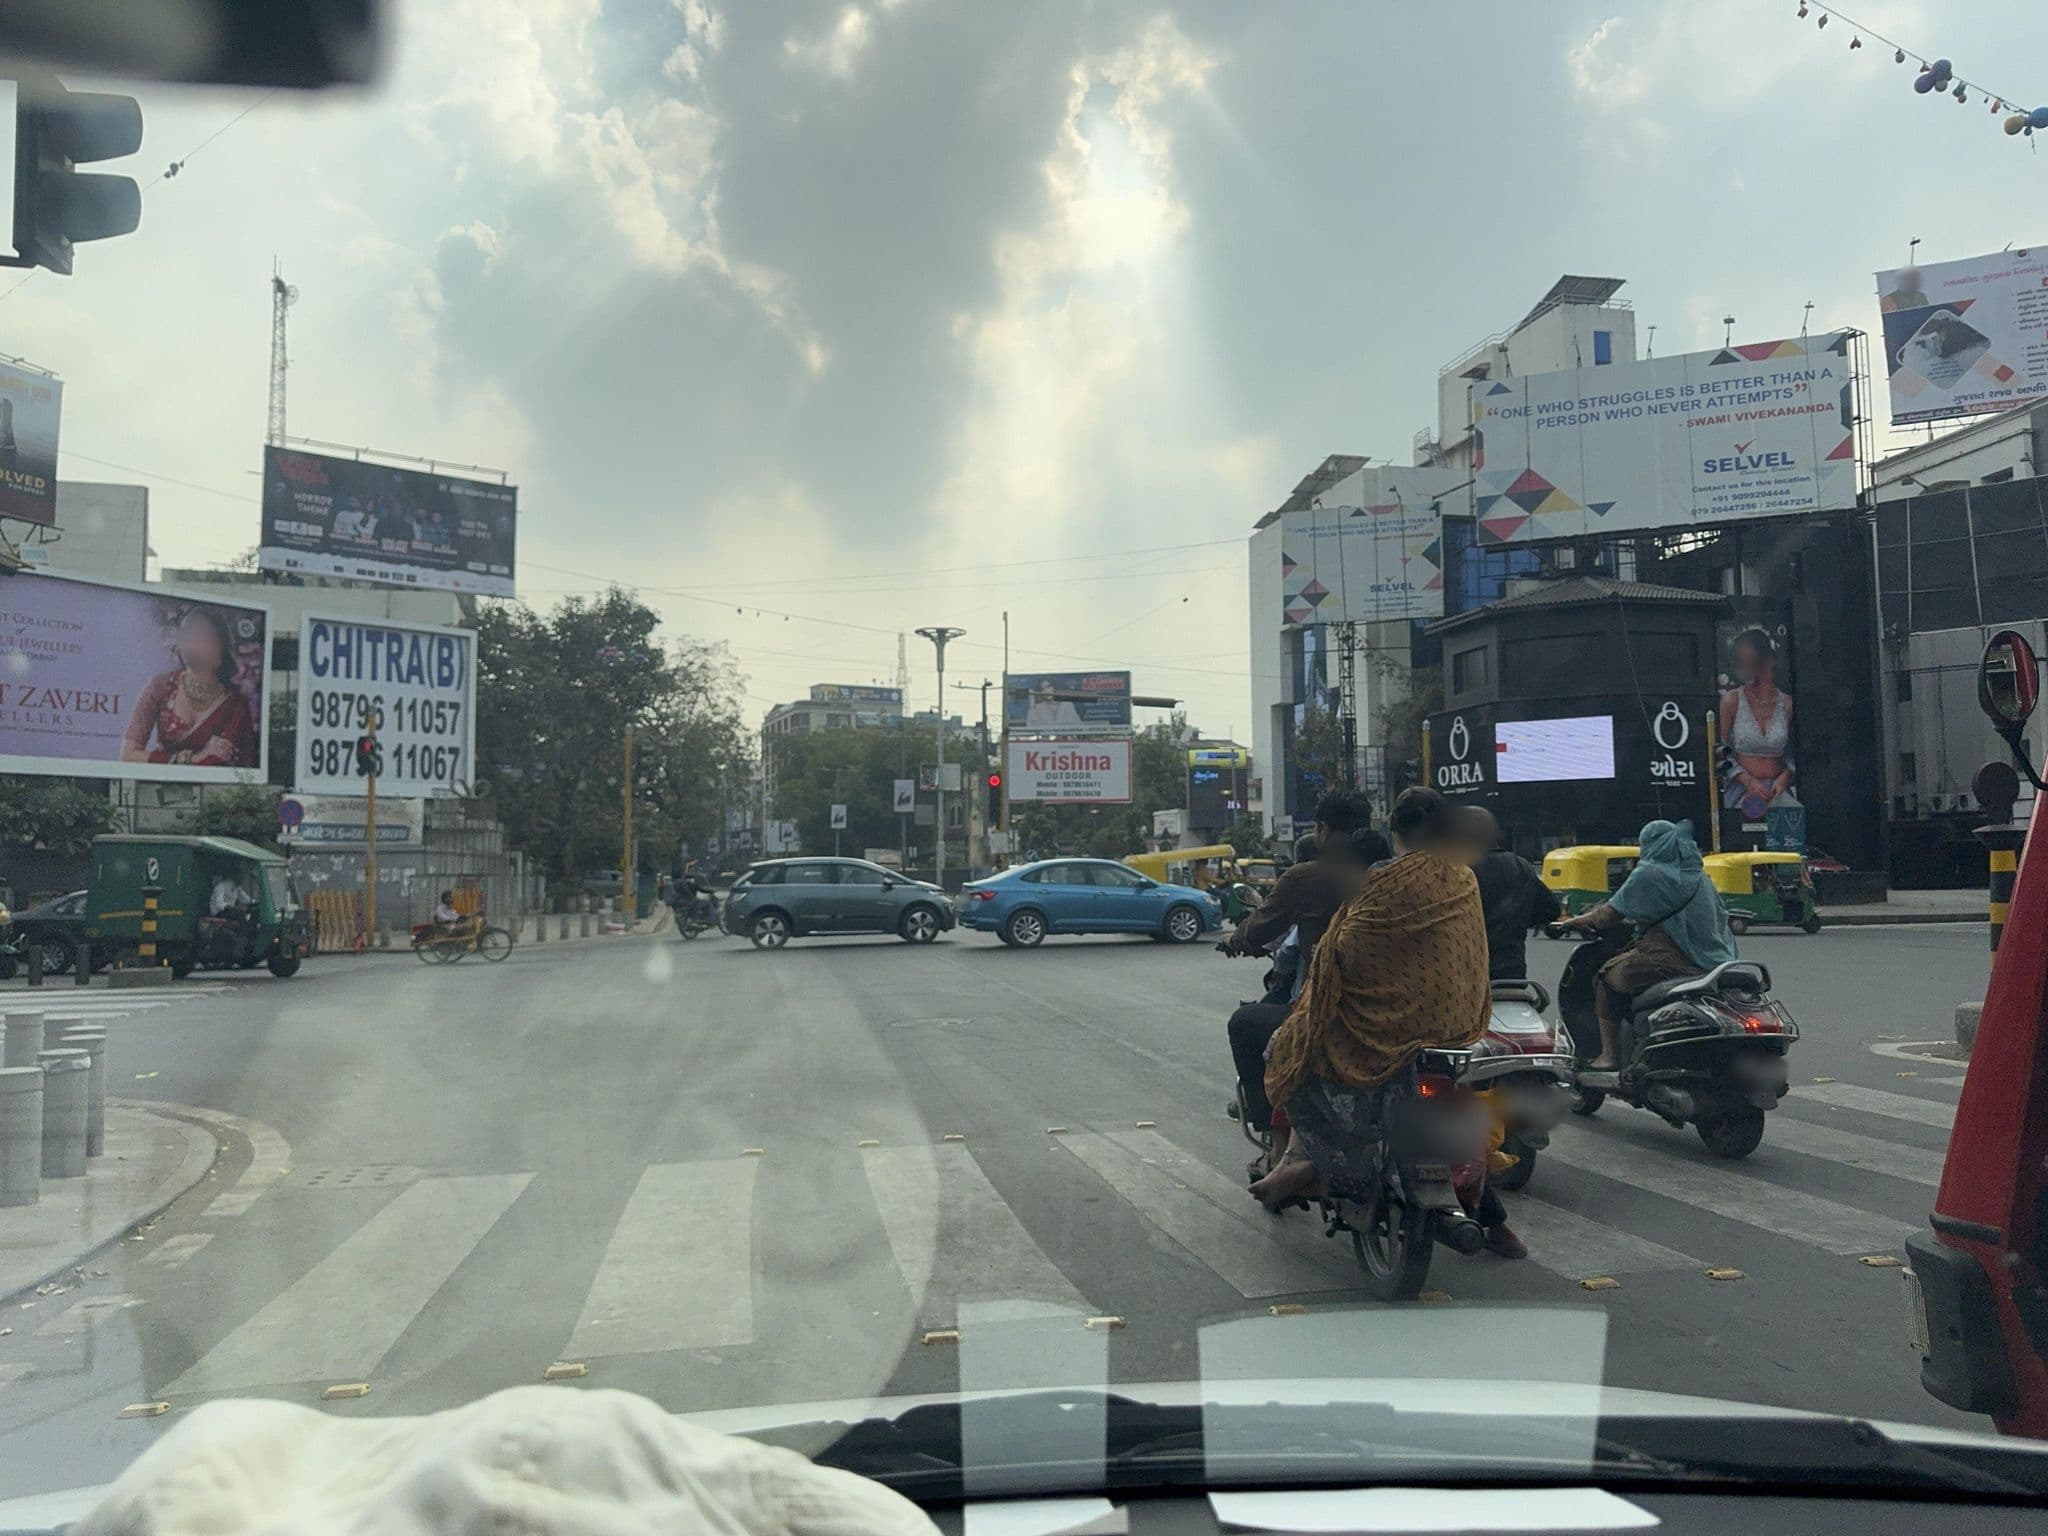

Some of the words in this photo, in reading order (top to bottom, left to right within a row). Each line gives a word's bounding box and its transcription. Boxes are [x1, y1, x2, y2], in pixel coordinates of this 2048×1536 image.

[1537, 400, 1574, 414] WHO
[1578, 387, 1675, 409] STRUGGLES
[1680, 385, 1695, 397] IS
[1700, 376, 1764, 394] BETTER
[1770, 369, 1815, 385] THAN
[1821, 368, 1833, 379] A
[1536, 411, 1600, 429] PERSON
[1604, 404, 1642, 420] WHO
[1648, 399, 1701, 415] NEVER
[1687, 415, 1731, 428] SWAMI
[1735, 402, 1834, 422] VIVEKANANDA
[1703, 451, 1795, 474] SELVEL
[1692, 483, 1726, 493] Contact
[1741, 480, 1753, 488] for
[1755, 478, 1772, 487] this
[1774, 475, 1811, 485] location
[1369, 582, 1416, 592] SELVEL
[310, 623, 464, 691] CHITRA(B)
[18, 685, 121, 714] ZAVERI
[312, 690, 385, 731] 98796
[394, 696, 461, 735] 11057
[393, 743, 461, 780] 11067
[1025, 751, 1111, 771] Krishna
[1438, 761, 1485, 787] ORRA
[1650, 753, 1696, 777] ઓરા
[1046, 772, 1092, 780] OUTDOOR
